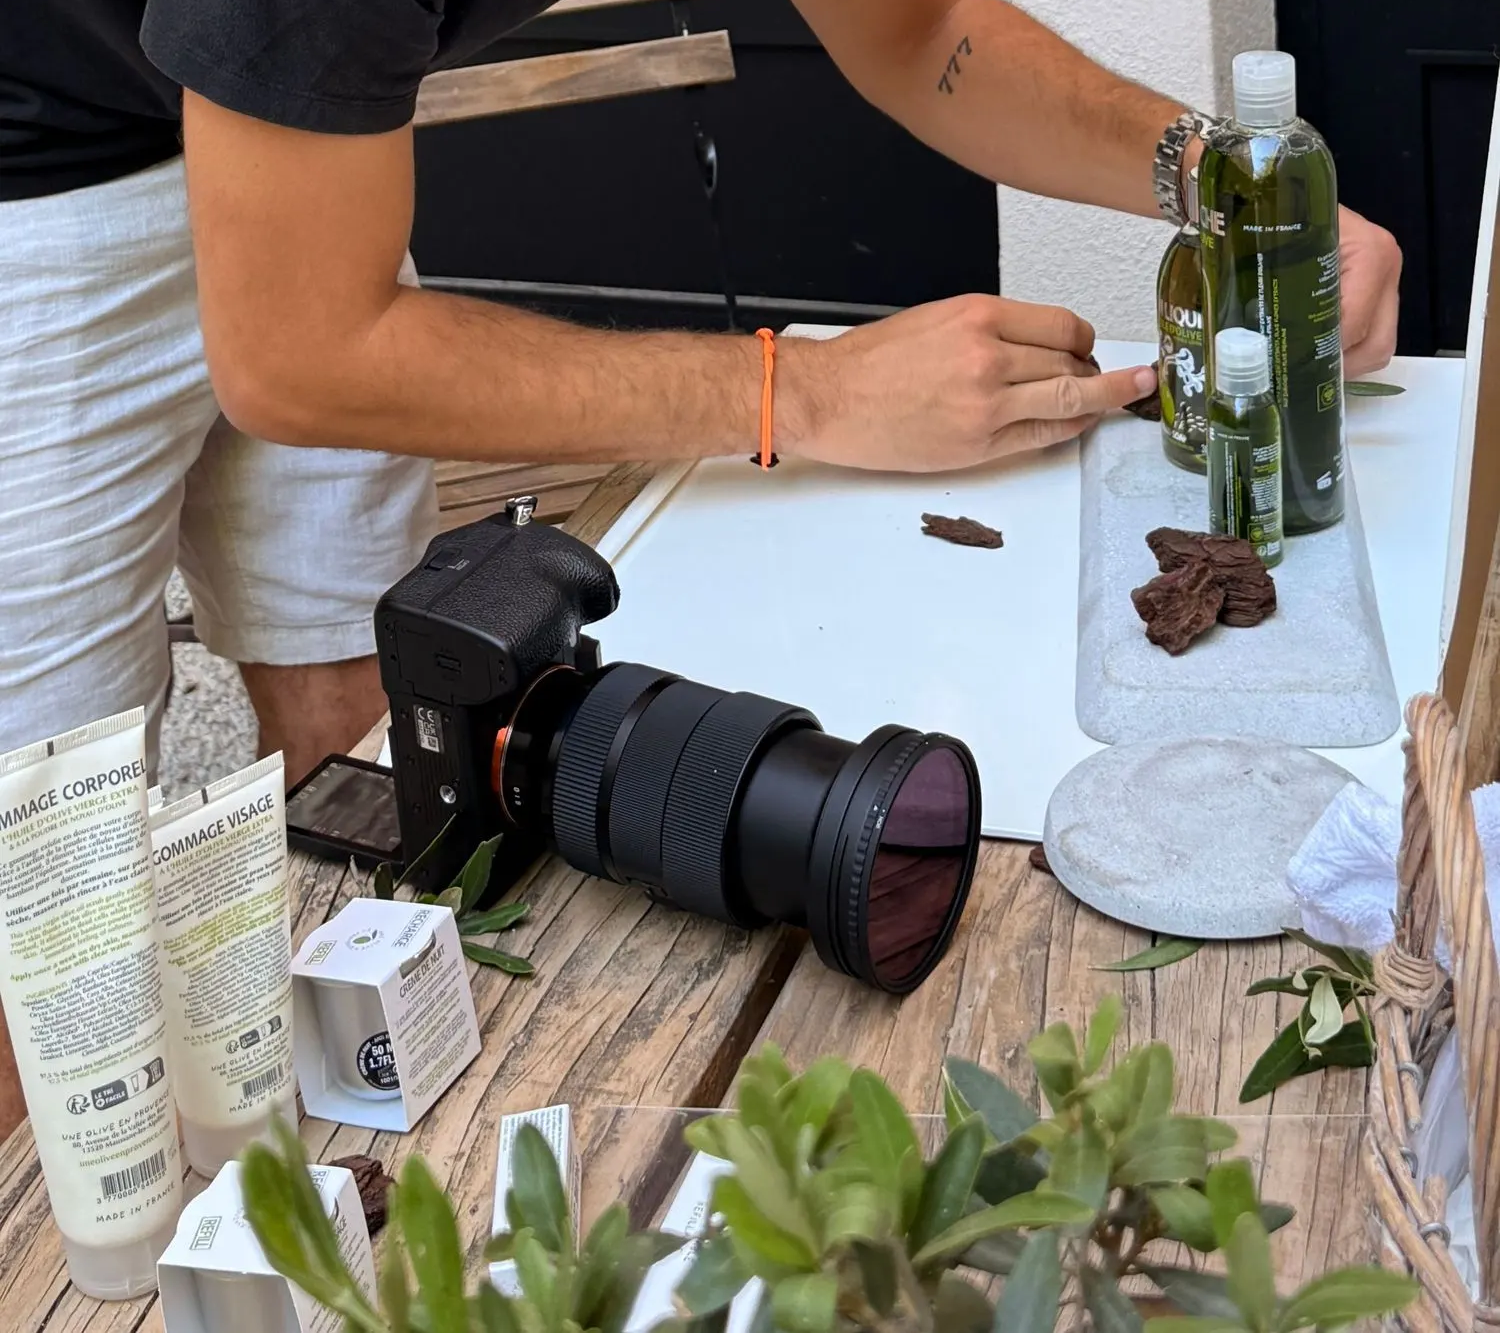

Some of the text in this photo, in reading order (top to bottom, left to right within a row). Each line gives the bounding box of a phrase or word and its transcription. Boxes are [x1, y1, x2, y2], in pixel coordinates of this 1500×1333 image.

[1275, 223, 1302, 231] FRANCE
[29, 823, 58, 840] POUDRE
[59, 818, 68, 828] DE
[70, 809, 96, 822] NOYAU
[97, 799, 127, 814] D'OLIVE
[36, 806, 72, 828] D'OLIVE
[74, 795, 107, 812] VIERGE
[110, 784, 140, 800] EXTRA
[153, 820, 225, 865] GOMMAGE
[227, 794, 274, 828] VISAGE
[5, 902, 35, 917] Utiliser
[36, 895, 50, 906] une
[66, 881, 79, 894] par
[81, 870, 116, 885] semaine,
[77, 884, 100, 898] rincer
[395, 910, 430, 947] RECHARGE
[371, 1044, 385, 1056] 50
[229, 1101, 253, 1113] MADE
[62, 1132, 81, 1141] UNE
[86, 1123, 115, 1138] OLIVE
[118, 1116, 131, 1127] EN
[85, 1135, 110, 1146] Avenue
[111, 1131, 120, 1139] de
[96, 1182, 175, 1223] MADE IN FRANCE
[194, 1217, 217, 1249] REFILL
